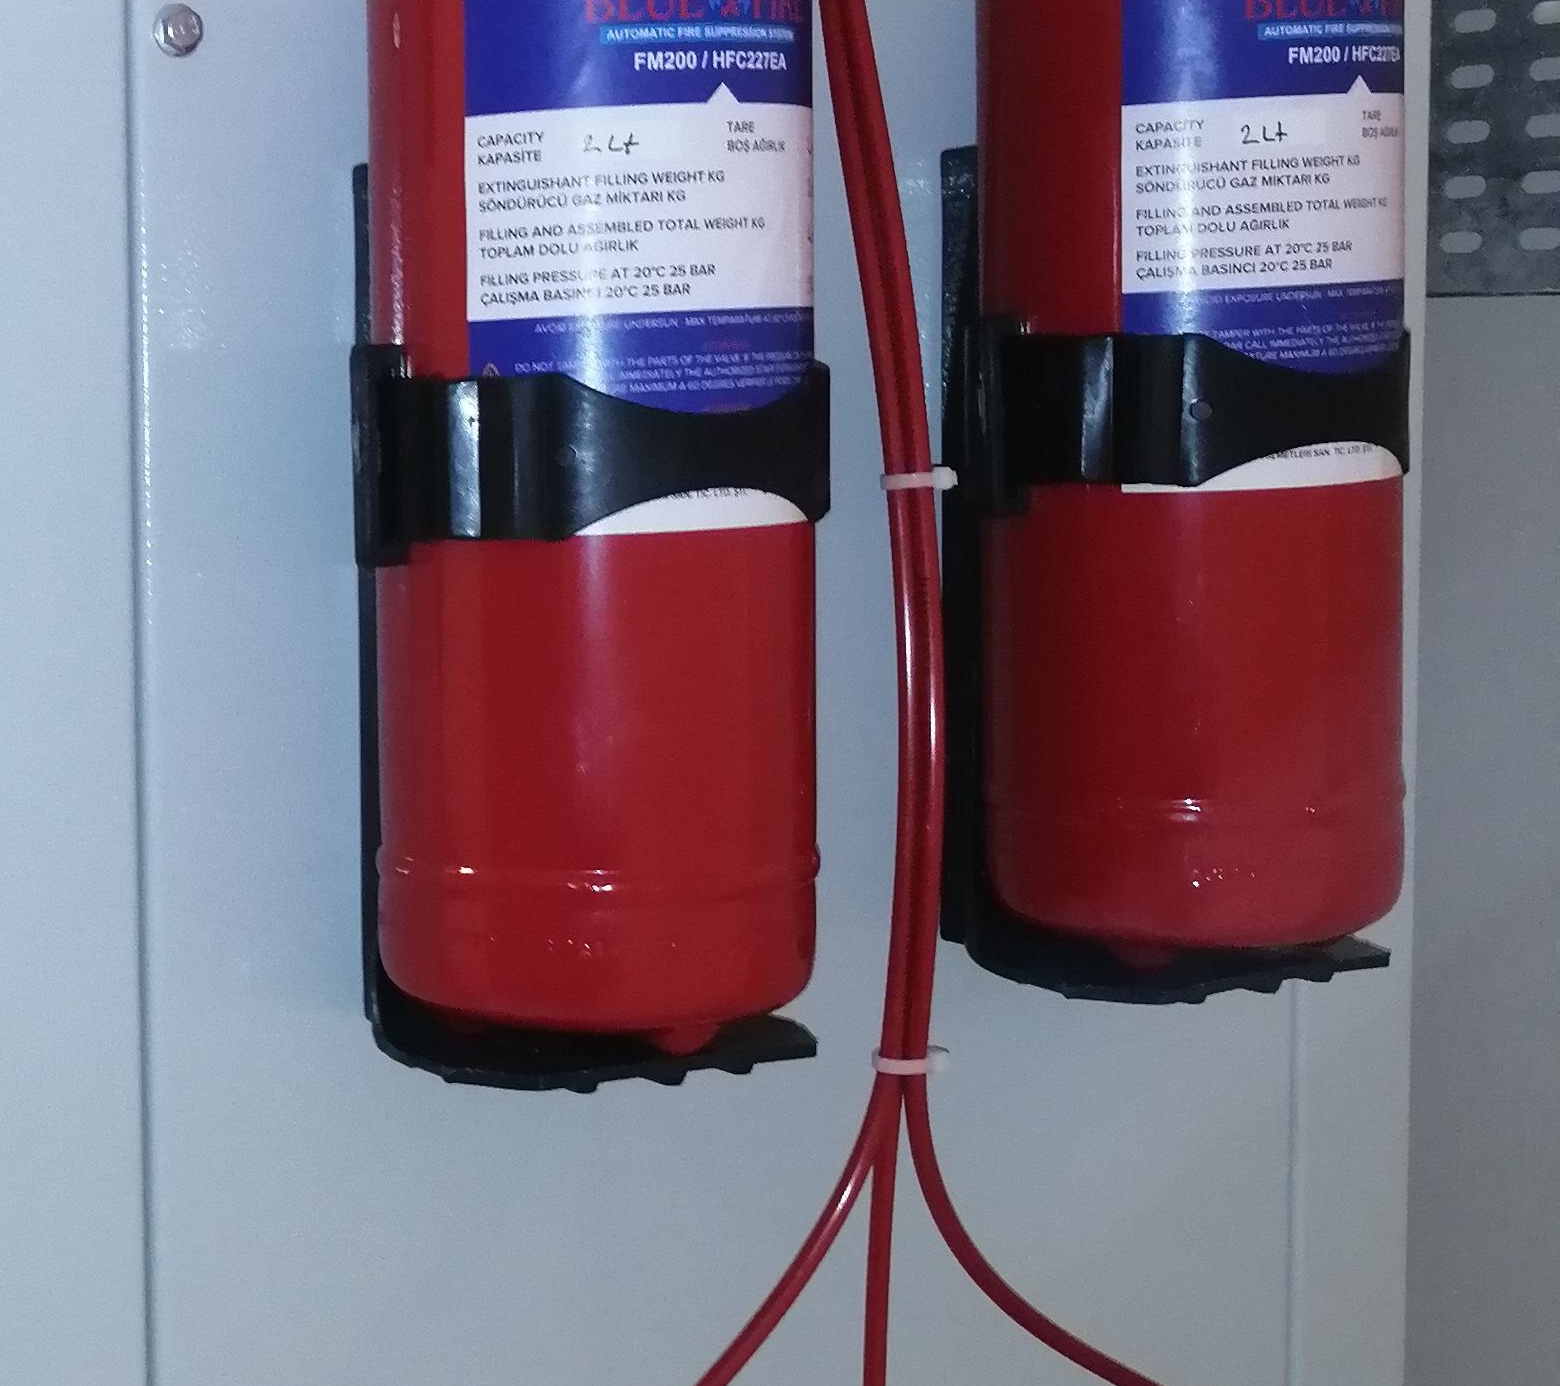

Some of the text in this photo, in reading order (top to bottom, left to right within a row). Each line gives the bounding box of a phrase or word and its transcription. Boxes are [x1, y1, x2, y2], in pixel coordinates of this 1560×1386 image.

[607, 25, 676, 41] AUTOMATIC
[1264, 24, 1322, 37] AUTOMATIC
[634, 50, 787, 71] FM200 / HFC227EA
[1289, 45, 1341, 64] FM200
[1343, 46, 1349, 62] /
[1135, 118, 1205, 134] CAPACITY
[1241, 124, 1260, 144] 2
[477, 131, 545, 148] CAPACITY
[477, 150, 542, 166] KAPASİTE
[1251, 157, 1299, 170] FILLING
[1302, 155, 1344, 168] WEIGHT
[478, 170, 725, 195] EXTINGUISHANT FILLING WEIGHT KG
[1230, 176, 1257, 189] GAZ
[1314, 173, 1330, 185] KG
[572, 193, 602, 207] GAZ
[667, 189, 686, 203] KG
[1193, 204, 1221, 217] AND
[1225, 201, 1303, 215] ASSEMBLED
[1305, 199, 1340, 211] TOTAL
[479, 216, 765, 242] FILLING AND ASSEMBLED TOTAL WEIGHT KG
[1197, 221, 1236, 234] DOLU
[479, 244, 535, 259] TOPLAM
[539, 242, 579, 256] DOLU
[1192, 244, 1261, 259] PRESSURE
[1265, 243, 1281, 256] AT
[1331, 240, 1353, 252] BAR
[480, 272, 529, 287] FILLING
[611, 266, 629, 279] AT
[669, 264, 686, 277] 25
[690, 263, 716, 276] BAR
[1202, 261, 1256, 276] BASINCI
[1292, 259, 1307, 271] 25
[1309, 258, 1332, 270] BAR
[480, 289, 540, 308] ÇALIŞMA
[642, 284, 660, 296] 25
[663, 283, 691, 296] BAR
